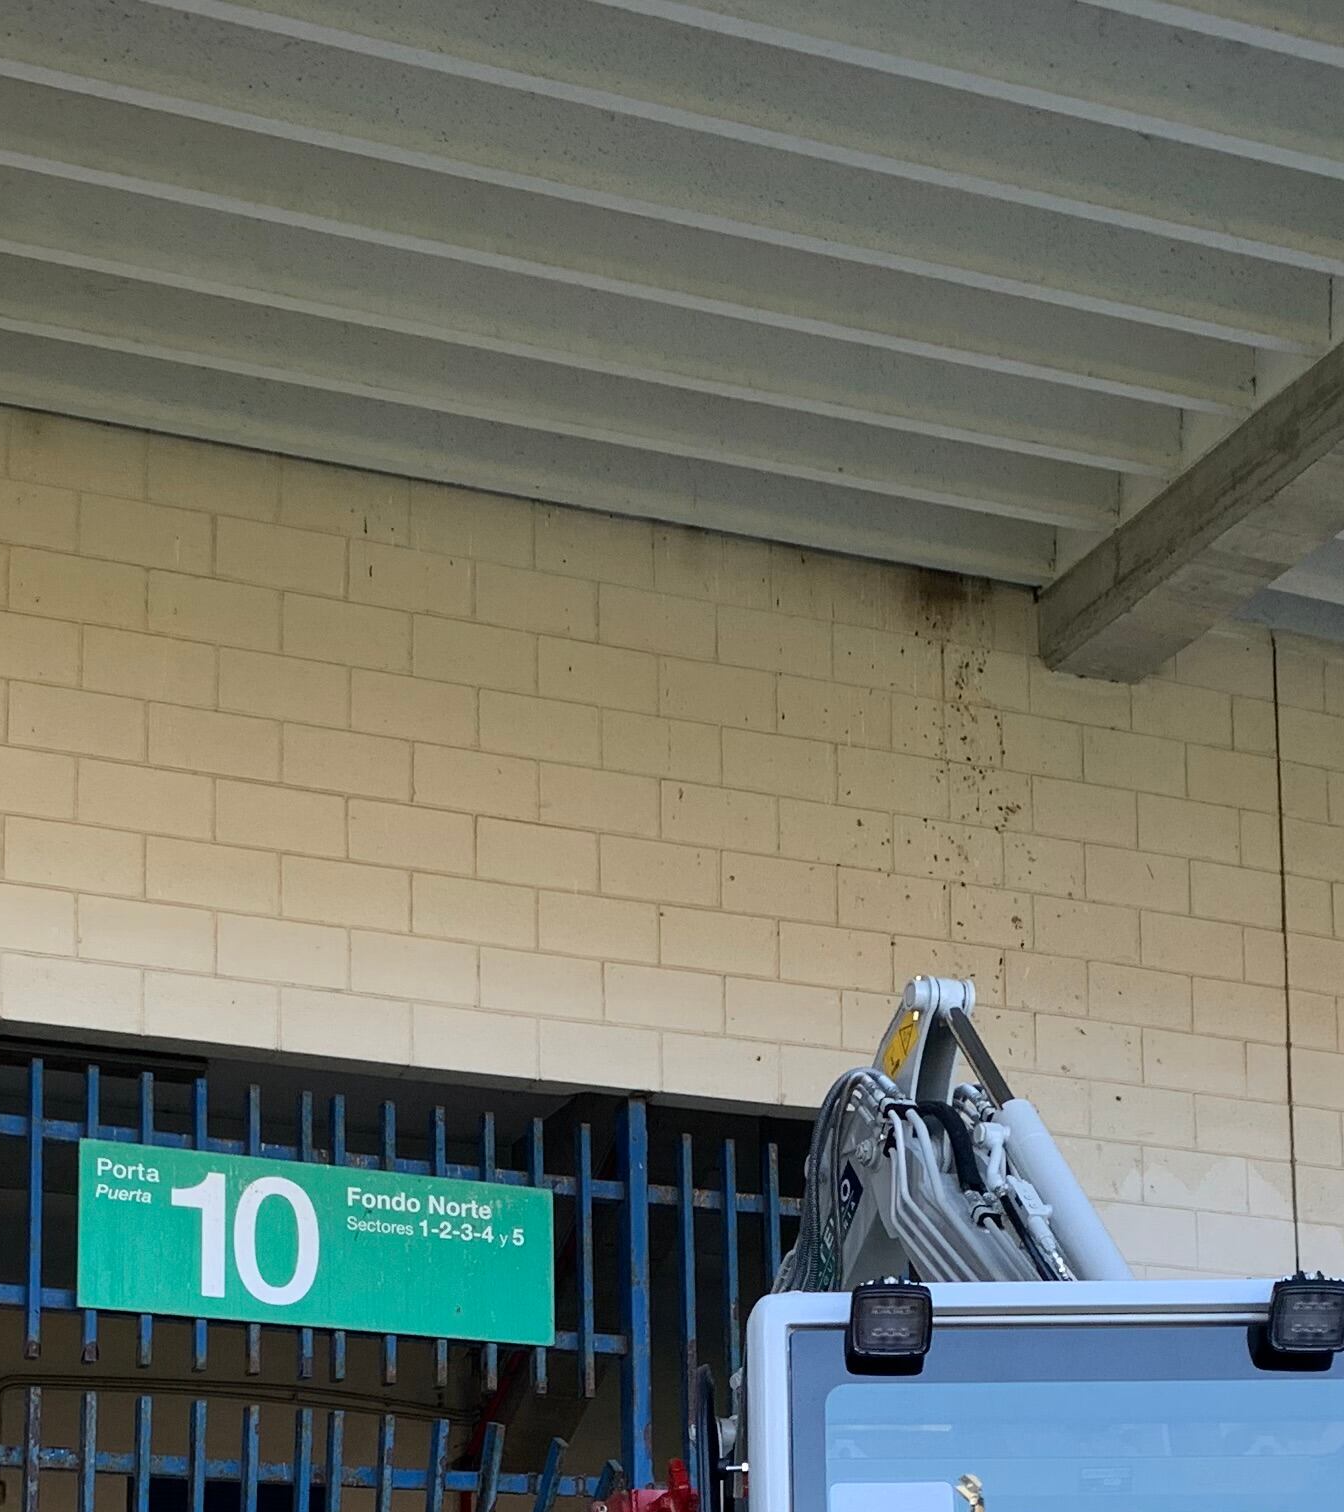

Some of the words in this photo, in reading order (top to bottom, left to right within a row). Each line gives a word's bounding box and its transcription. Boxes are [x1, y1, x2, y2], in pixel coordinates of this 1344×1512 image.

[96, 1157, 160, 1183] Porta
[95, 1183, 153, 1204] Puerta
[346, 1186, 421, 1213] Fondo
[428, 1194, 492, 1220] Norte
[170, 1171, 320, 1306] 10
[346, 1215, 414, 1236] Sectores
[419, 1219, 494, 1243] 1-2-3-4
[499, 1233, 508, 1248] y
[512, 1228, 525, 1246] 5
